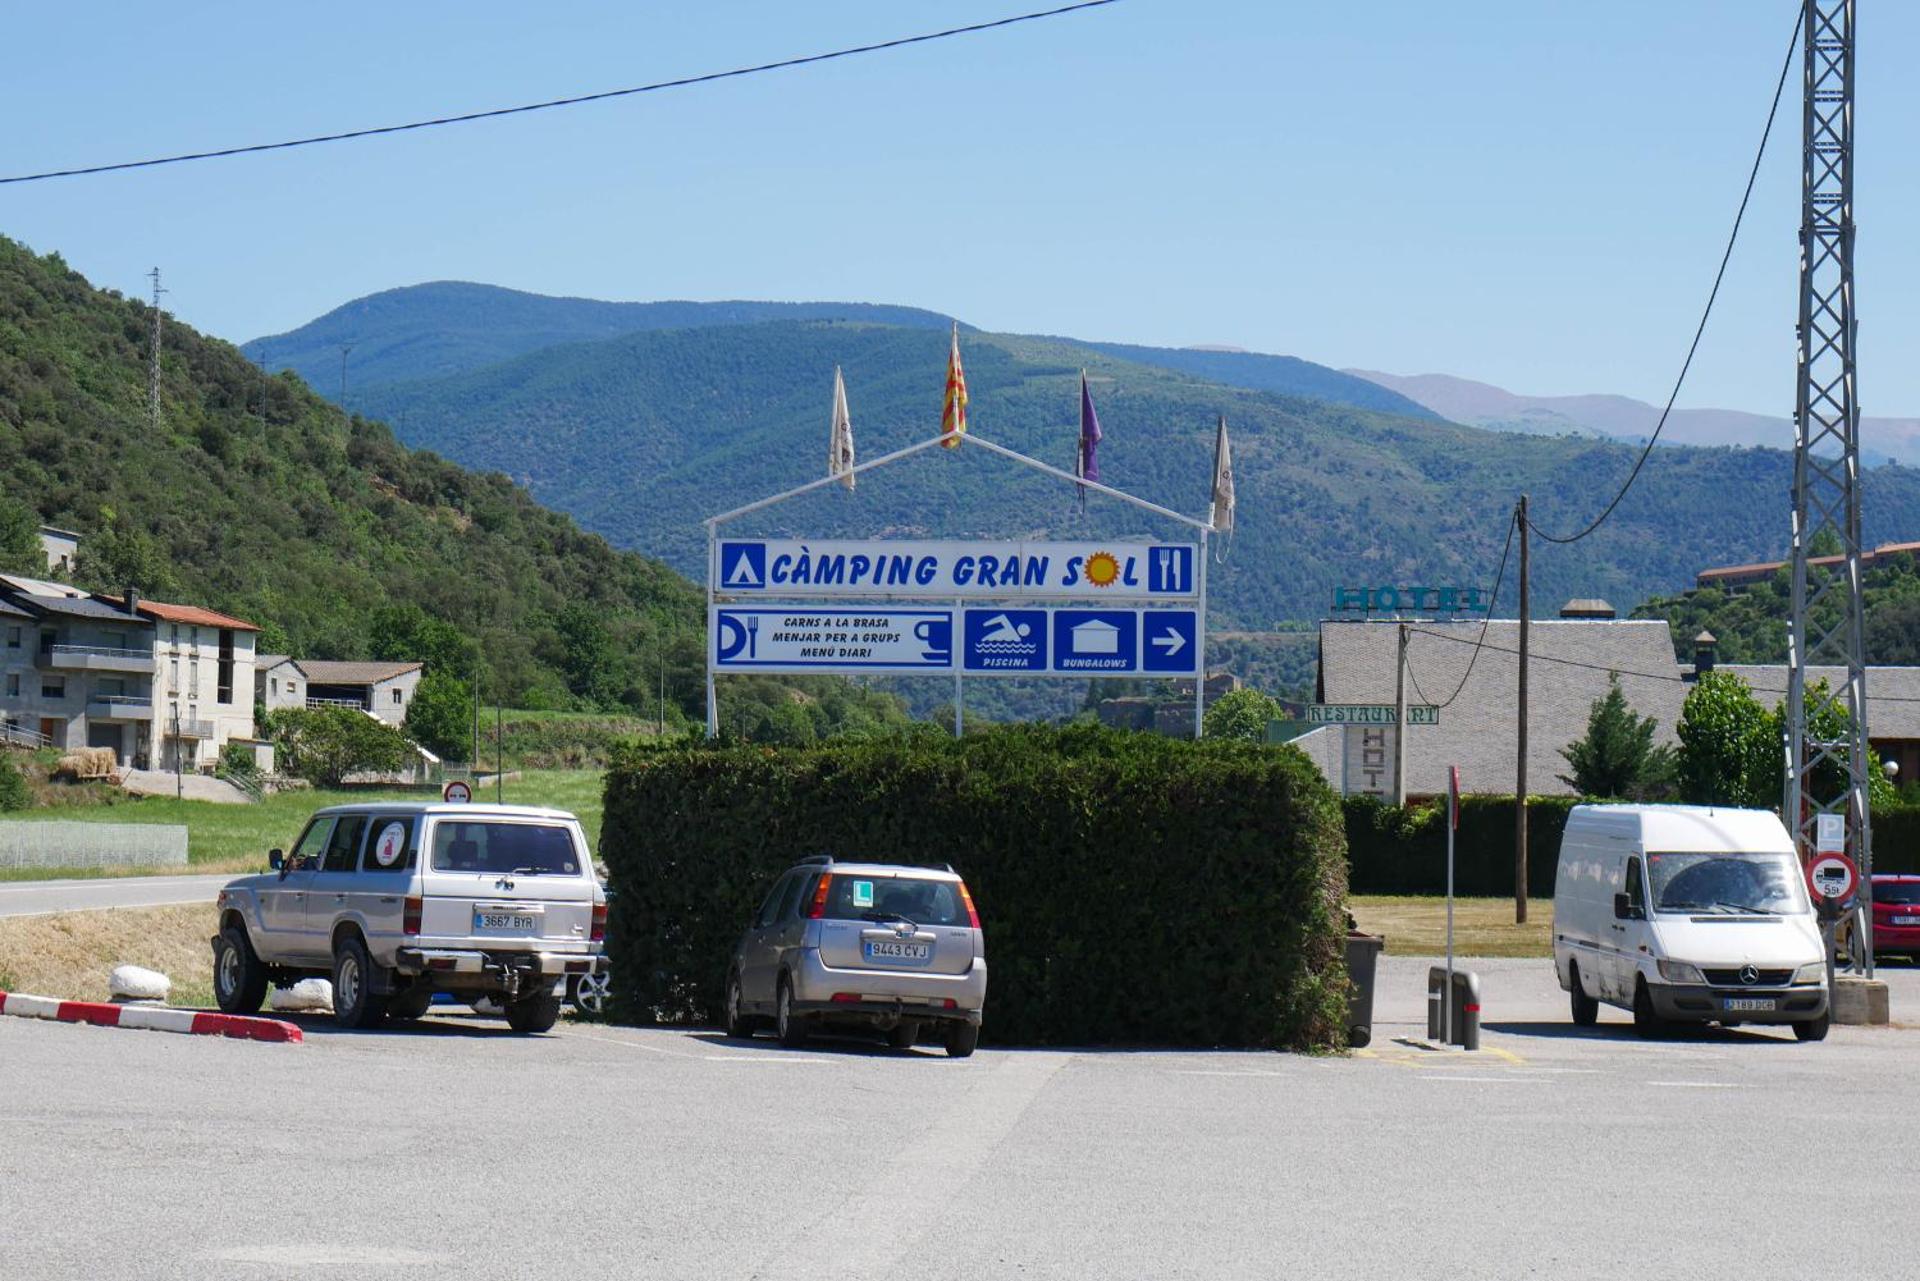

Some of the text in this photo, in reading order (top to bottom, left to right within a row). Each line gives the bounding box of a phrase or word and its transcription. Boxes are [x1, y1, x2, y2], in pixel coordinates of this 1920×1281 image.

[771, 545, 1138, 587] CÀMPING GRAN SOL
[1335, 585, 1488, 612] HOTEL
[784, 618, 889, 628] CARNS A LA BRASA
[772, 632, 900, 643] MENJAR PER A GRUPS
[800, 645, 872, 658] MENÚ DIARI
[983, 658, 1029, 667] PISCINA
[1063, 658, 1128, 668] BUNGALOWS
[1310, 707, 1437, 722] RESTAURNT
[1363, 728, 1385, 797] HOT
[1823, 820, 1839, 837] P
[855, 883, 870, 901] L
[484, 915, 533, 928] 3667 BYR
[873, 943, 927, 957] 9443 CVJ
